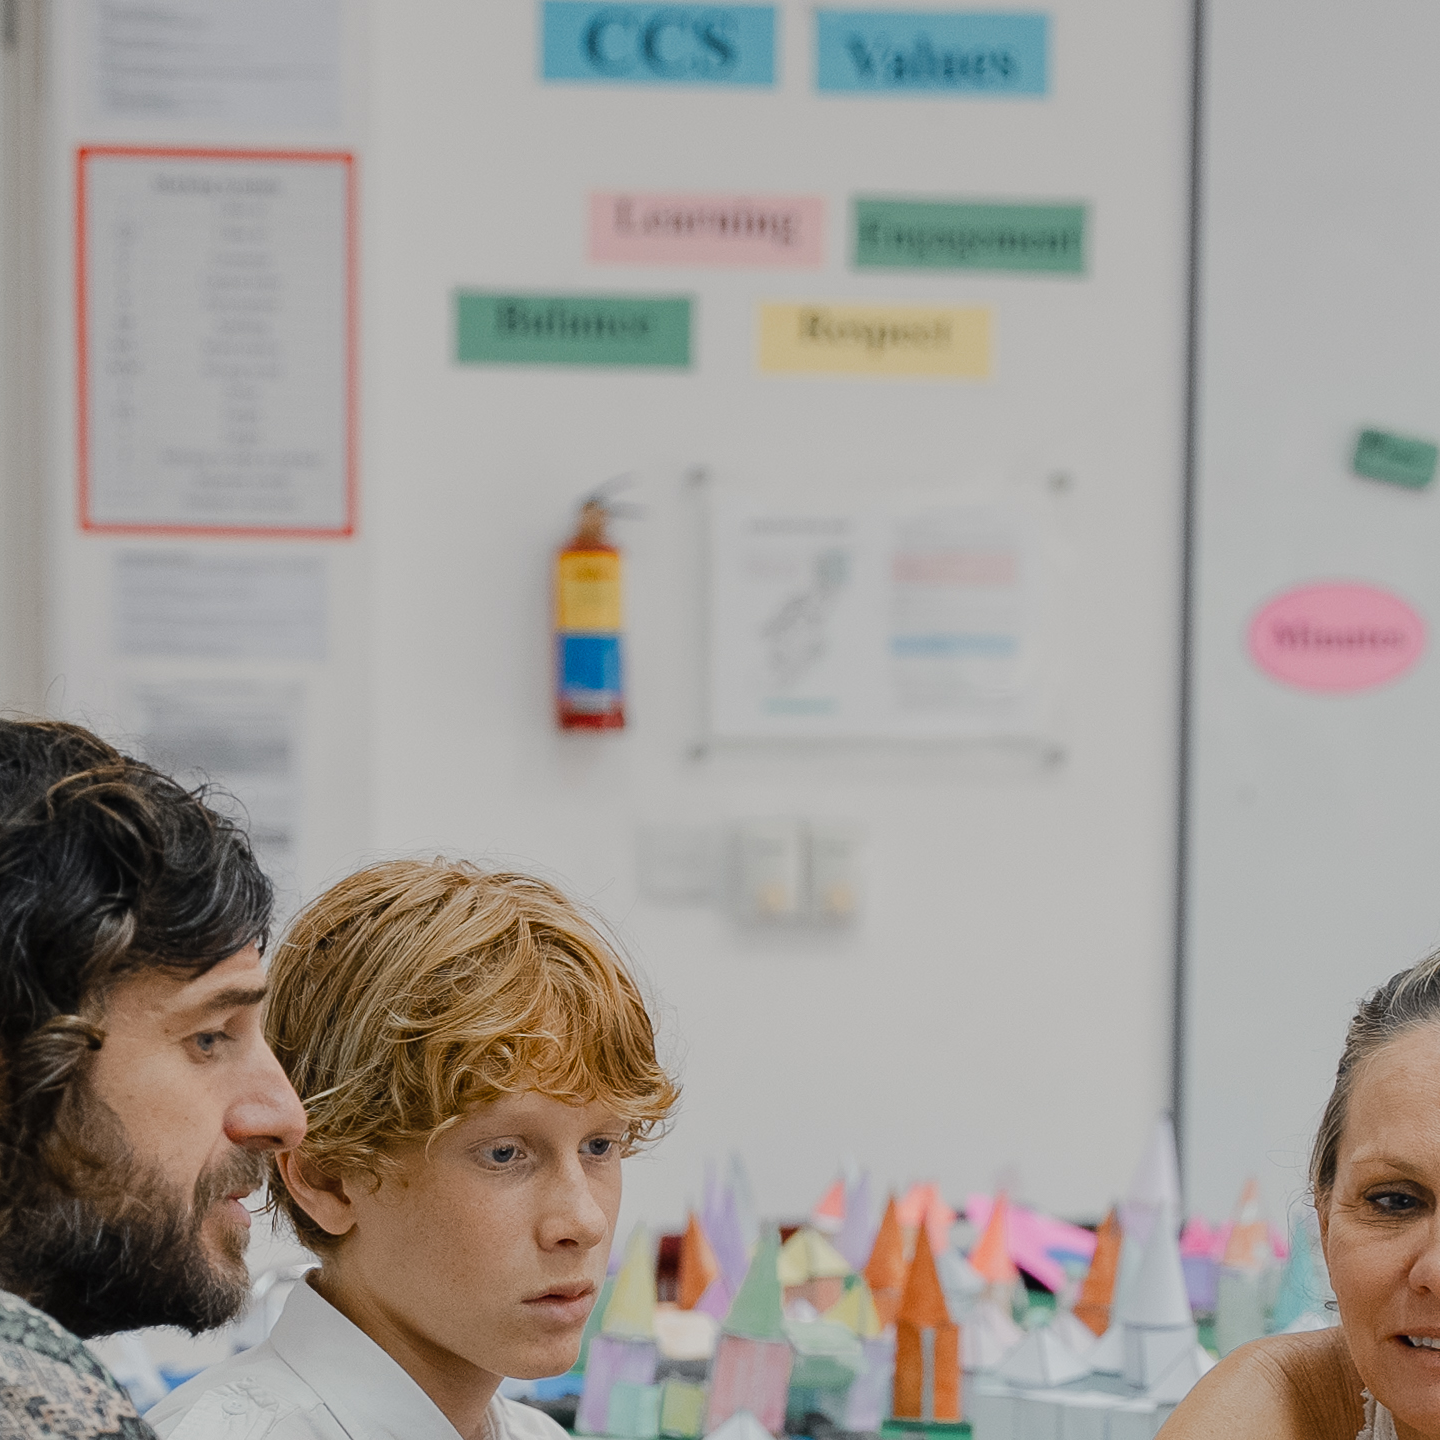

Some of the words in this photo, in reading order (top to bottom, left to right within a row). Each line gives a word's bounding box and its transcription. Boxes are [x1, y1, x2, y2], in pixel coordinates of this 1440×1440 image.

[580, 8, 739, 76] CCS
[847, 30, 1017, 84] Values
[615, 198, 795, 246] Learning
[861, 216, 1075, 260] Engagement
[799, 310, 951, 352] Respect
